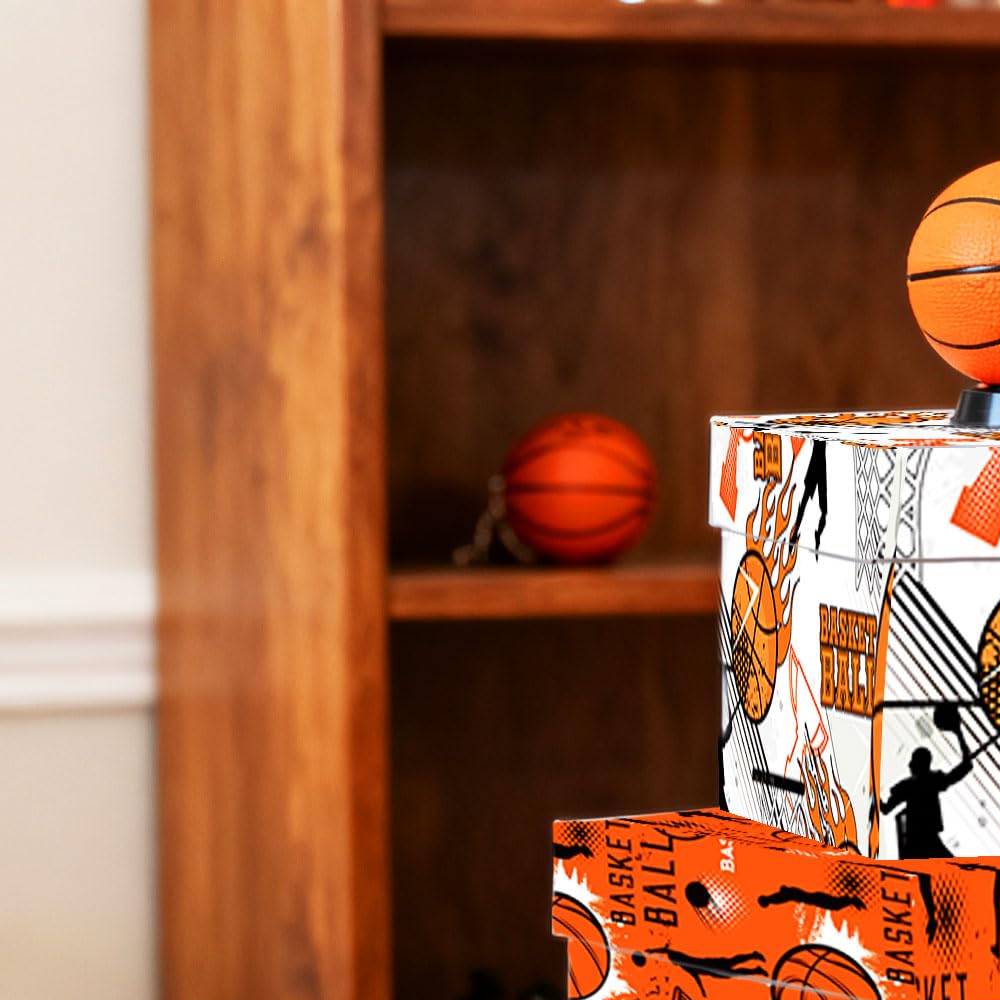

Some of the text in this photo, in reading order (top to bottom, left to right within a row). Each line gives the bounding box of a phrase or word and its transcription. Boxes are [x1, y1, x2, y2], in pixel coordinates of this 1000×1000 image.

[819, 603, 877, 657] BASKET
[605, 819, 636, 926] BASKET
[639, 836, 679, 927] BALL
[879, 870, 915, 985] BASKET
